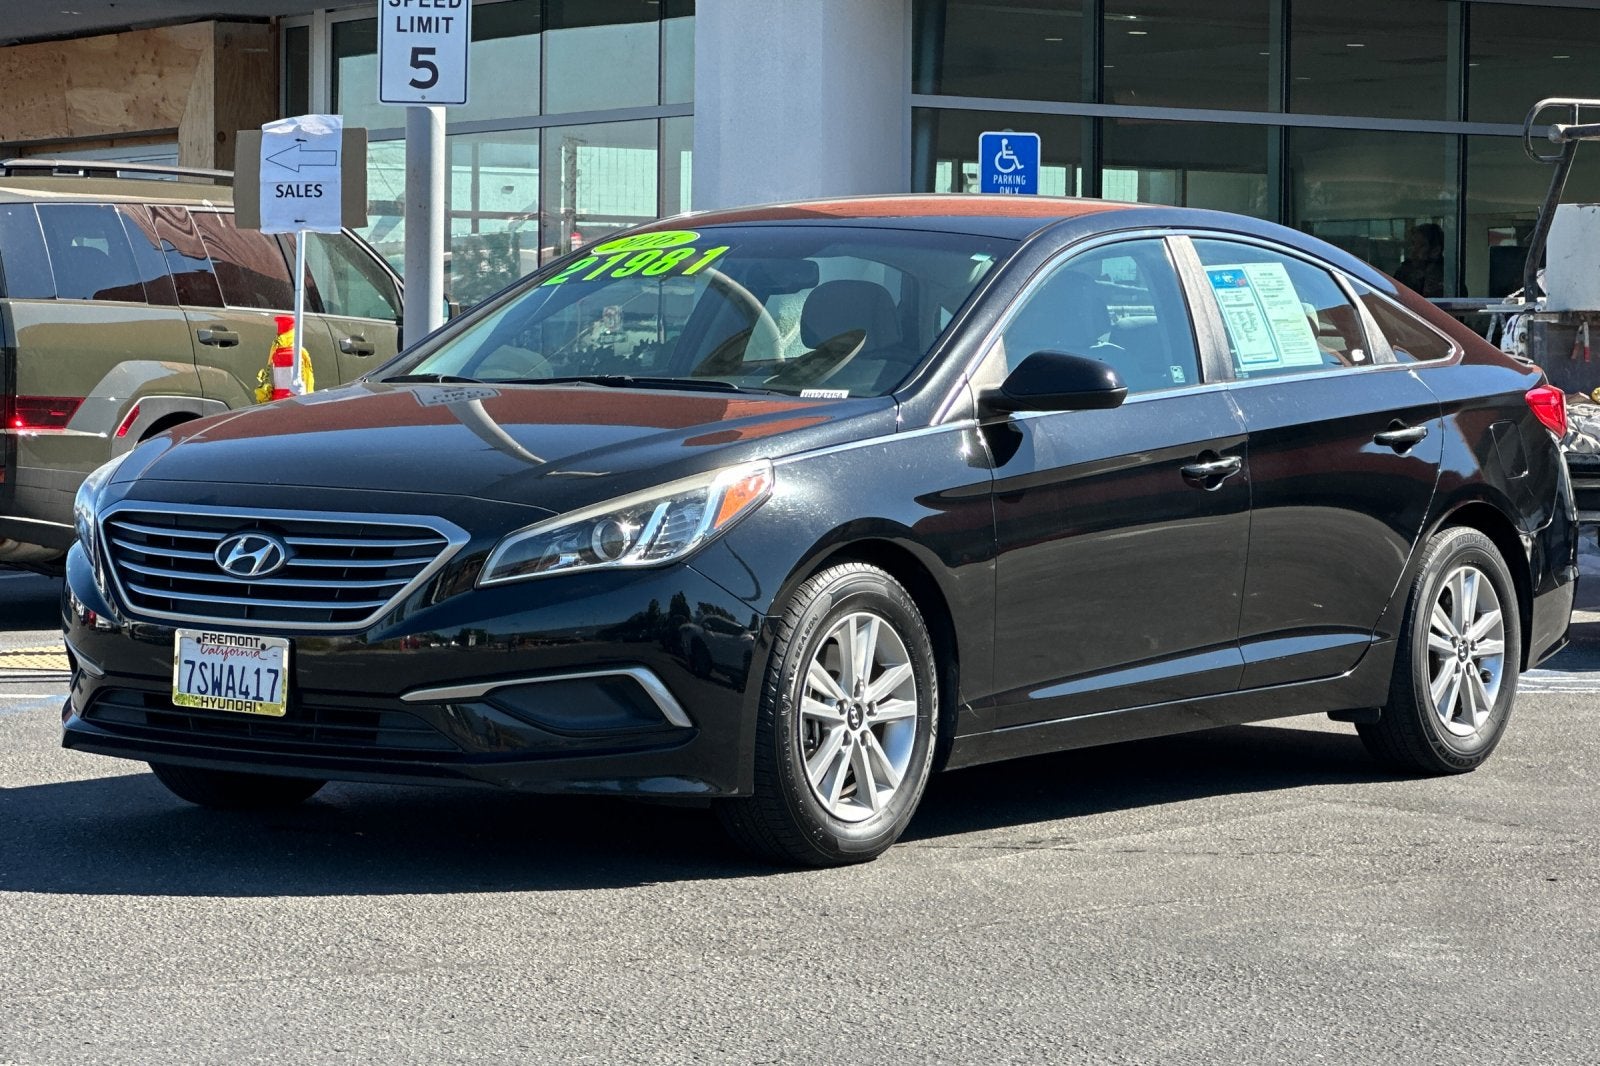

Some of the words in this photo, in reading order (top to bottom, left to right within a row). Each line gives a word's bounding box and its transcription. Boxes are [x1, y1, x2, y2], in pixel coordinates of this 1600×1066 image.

[396, 16, 454, 34] LIMIT
[408, 47, 439, 90] 5
[993, 174, 1026, 185] PARKING
[275, 184, 323, 199] SALES
[541, 246, 730, 287] 21981
[201, 632, 261, 648] FREMONT
[200, 644, 267, 662] California
[183, 659, 279, 703] 7SWA417
[201, 696, 257, 713] HYUNDAI
